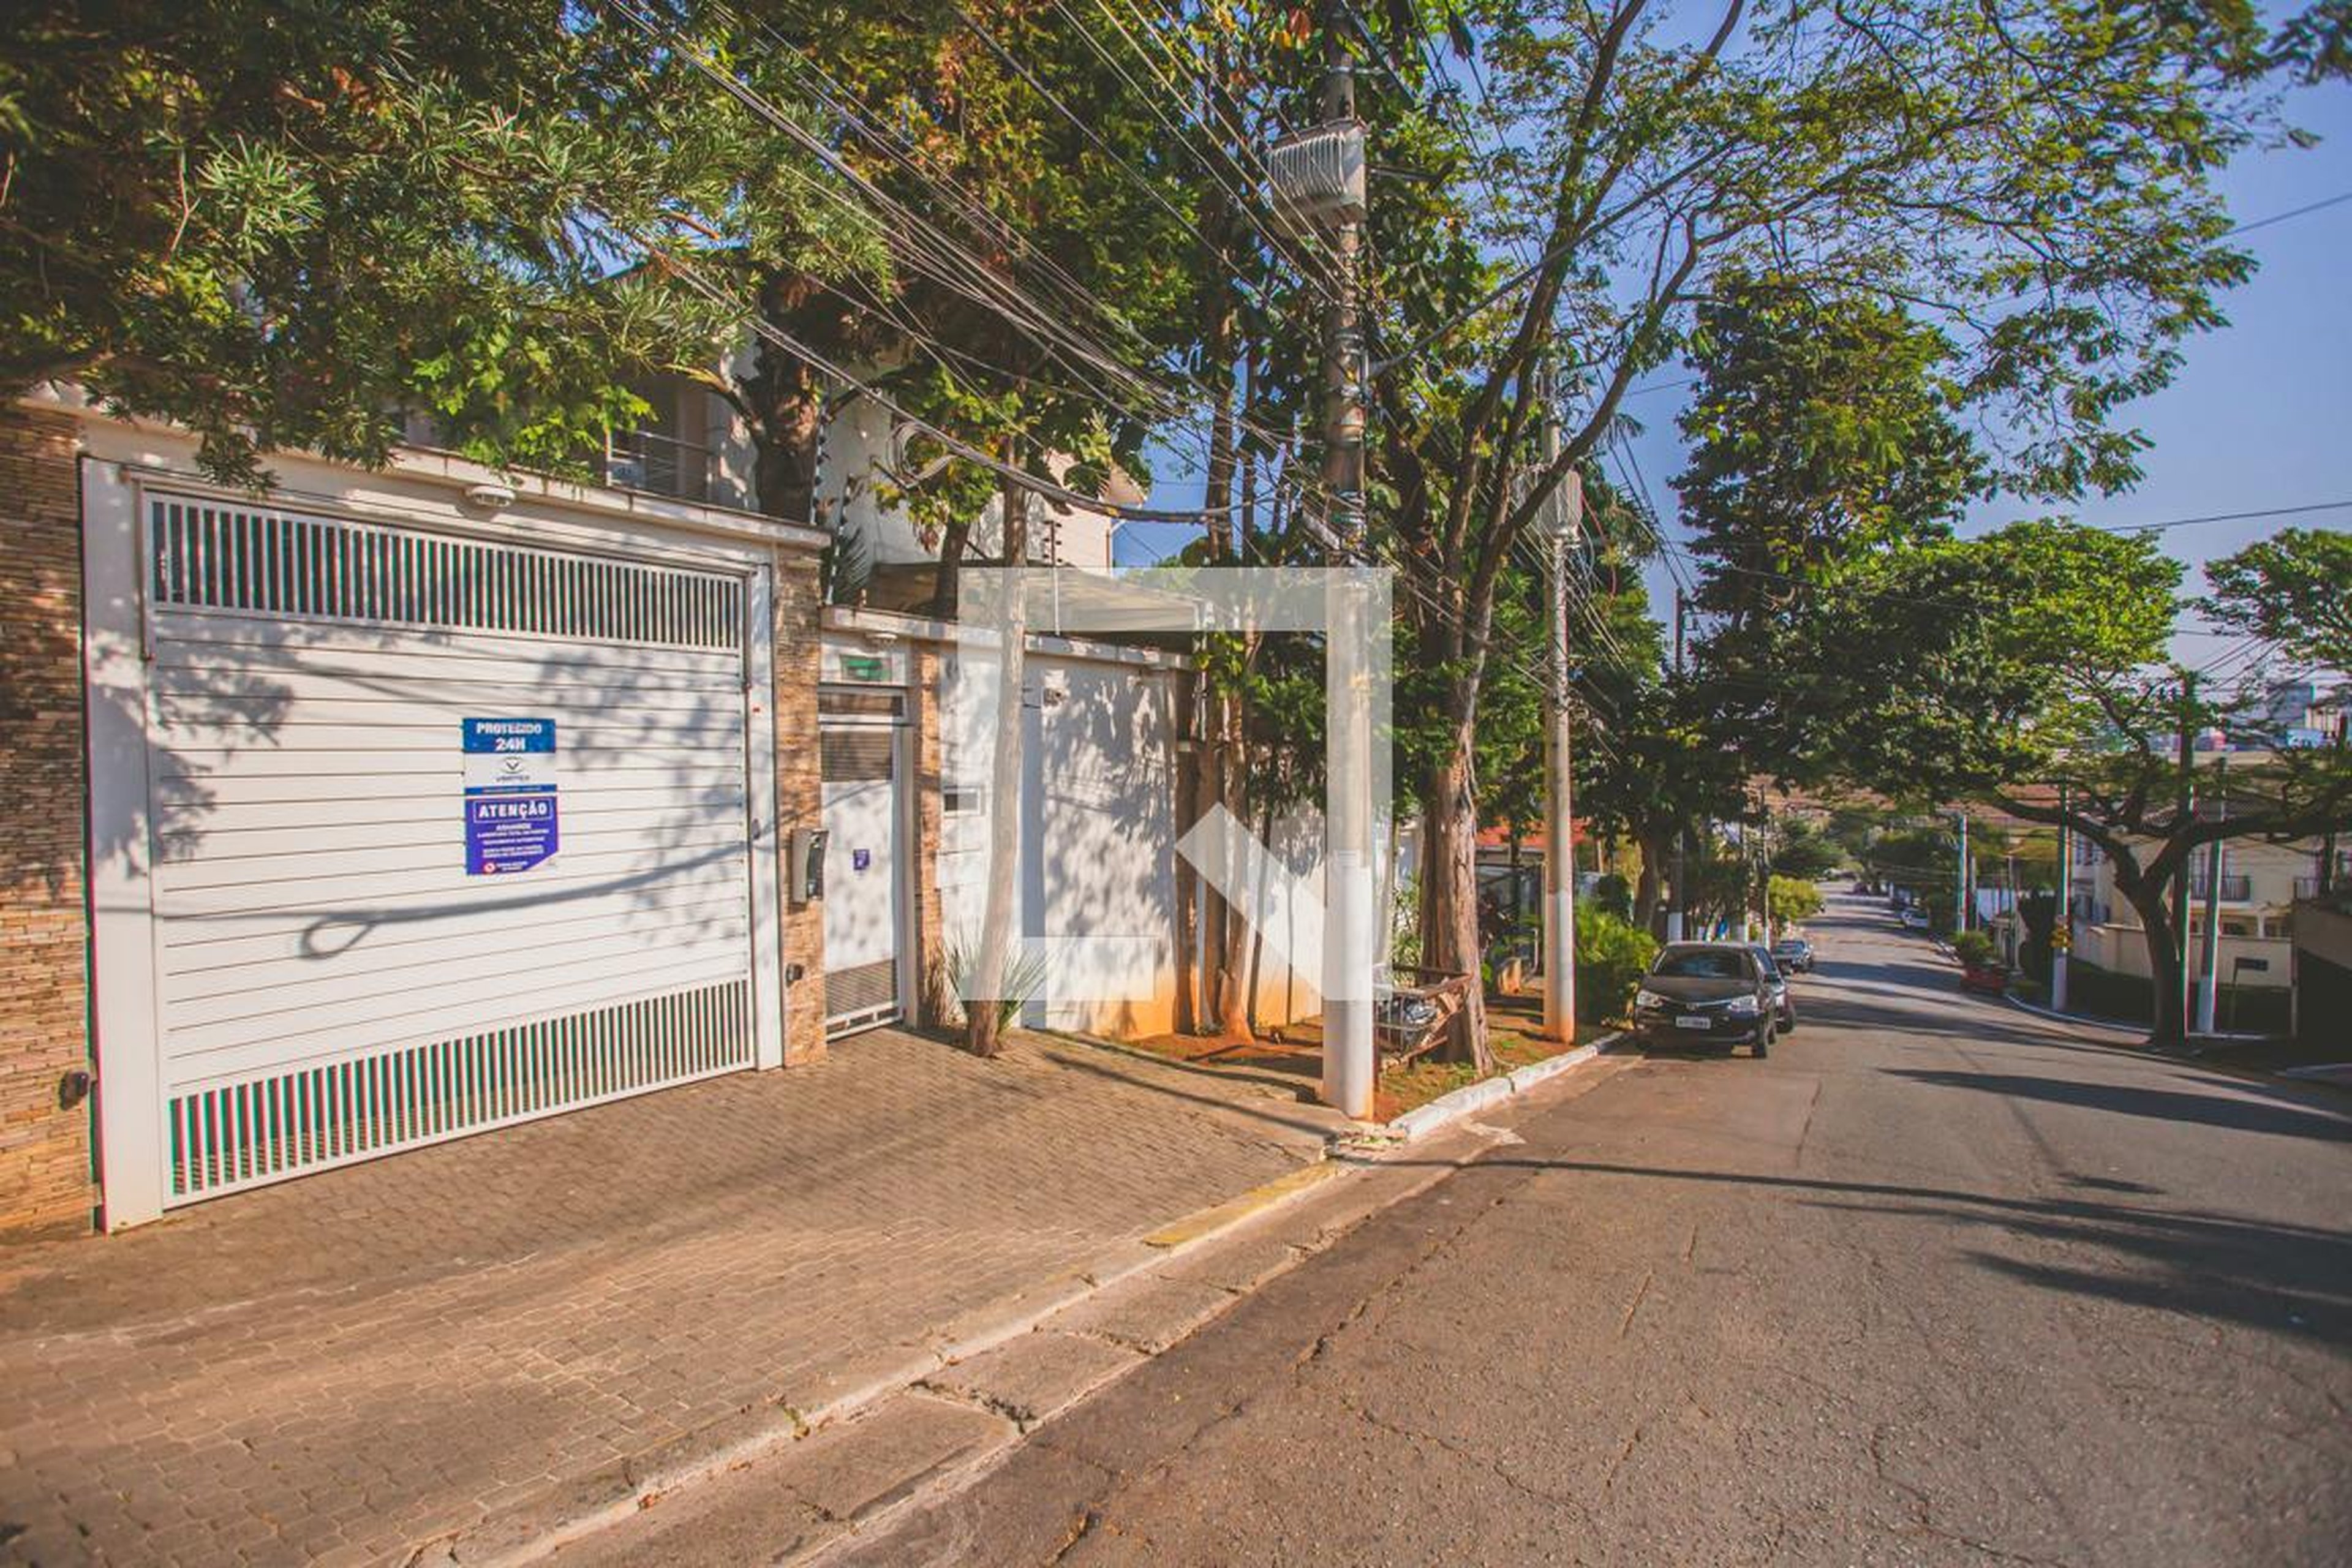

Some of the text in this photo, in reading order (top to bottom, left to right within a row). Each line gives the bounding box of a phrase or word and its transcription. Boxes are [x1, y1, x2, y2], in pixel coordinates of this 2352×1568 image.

[477, 722, 542, 734] PROTEGIDO
[495, 737, 526, 751] 24H
[478, 801, 547, 819] ATENÇÃO
